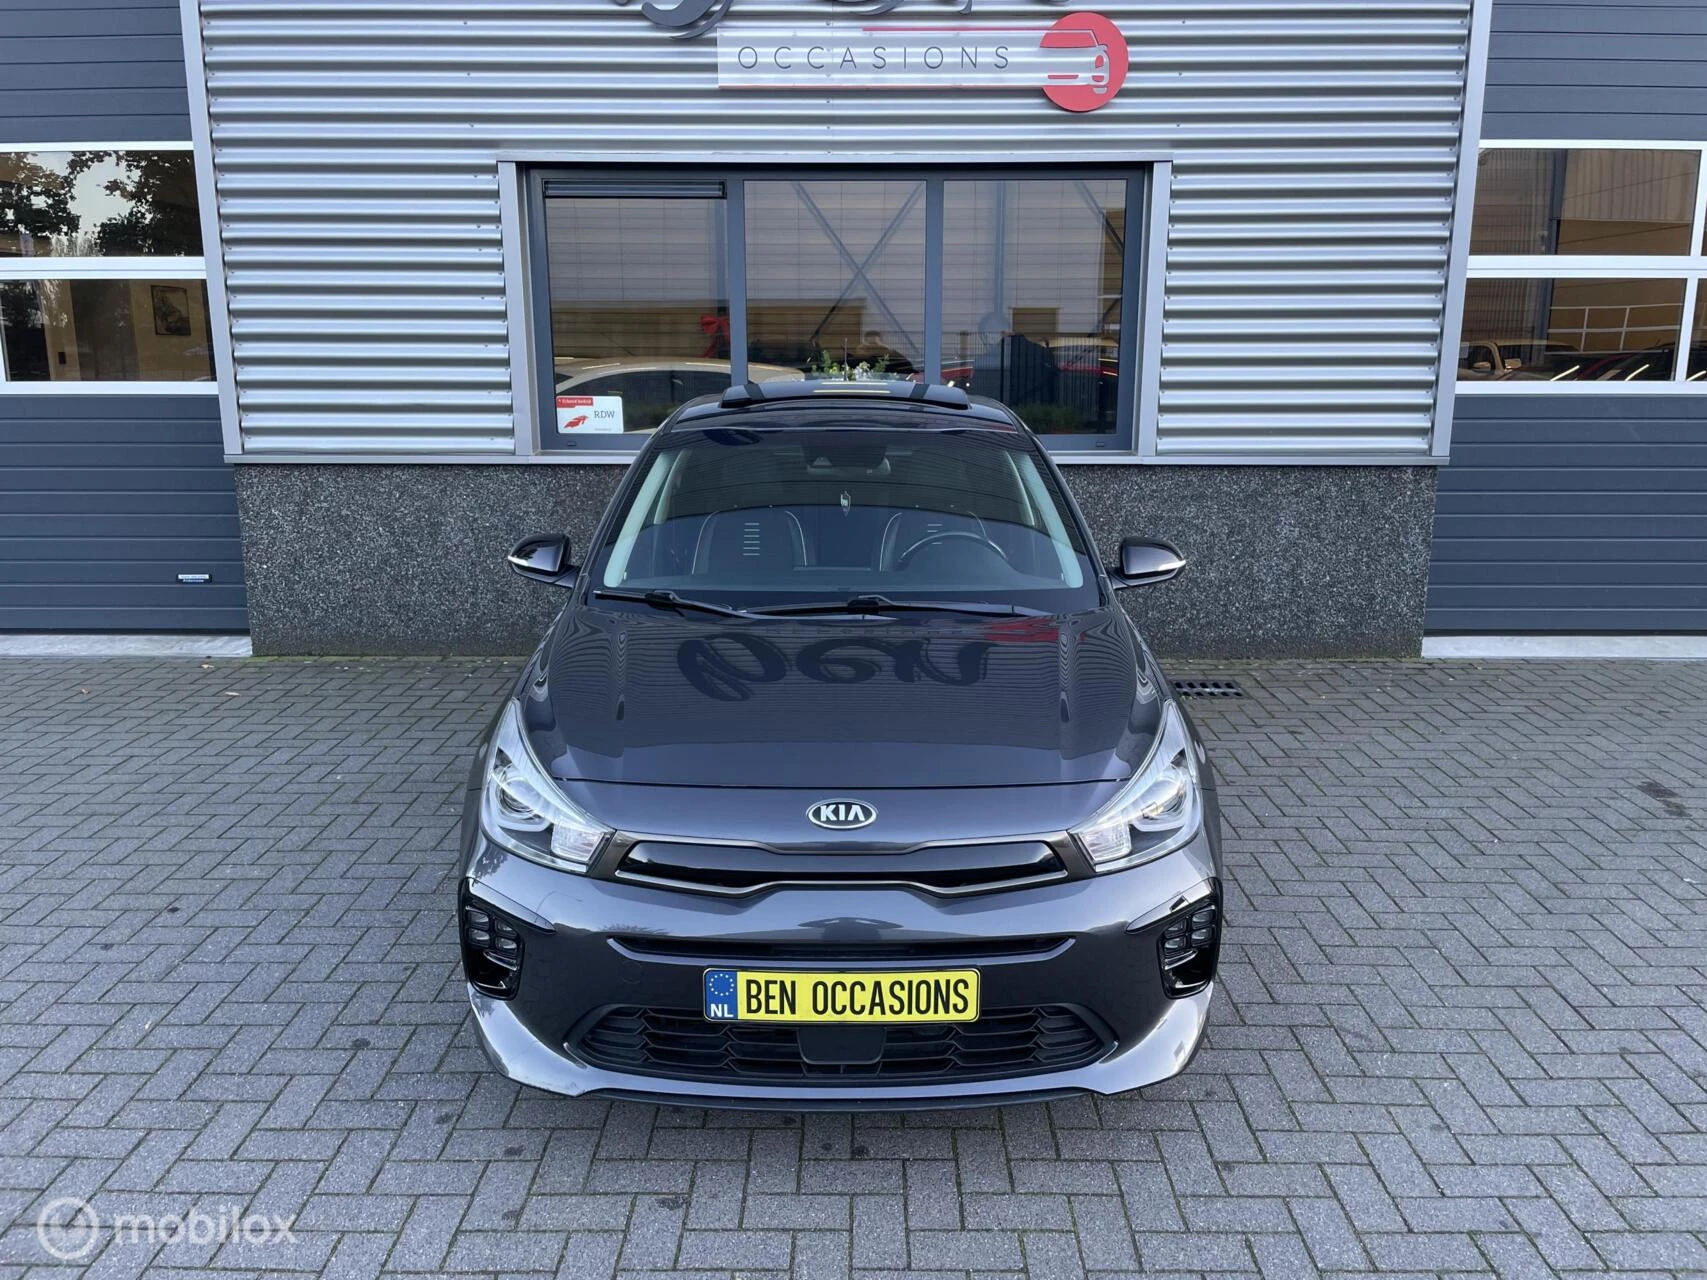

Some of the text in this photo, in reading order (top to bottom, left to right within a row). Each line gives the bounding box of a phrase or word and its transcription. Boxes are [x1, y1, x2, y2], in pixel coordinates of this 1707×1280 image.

[736, 45, 1010, 70] OCCASIONS
[594, 410, 615, 419] RDW
[820, 803, 866, 822] KIA
[745, 978, 970, 1016] BEN OCCASIONS
[710, 1002, 734, 1018] NL
